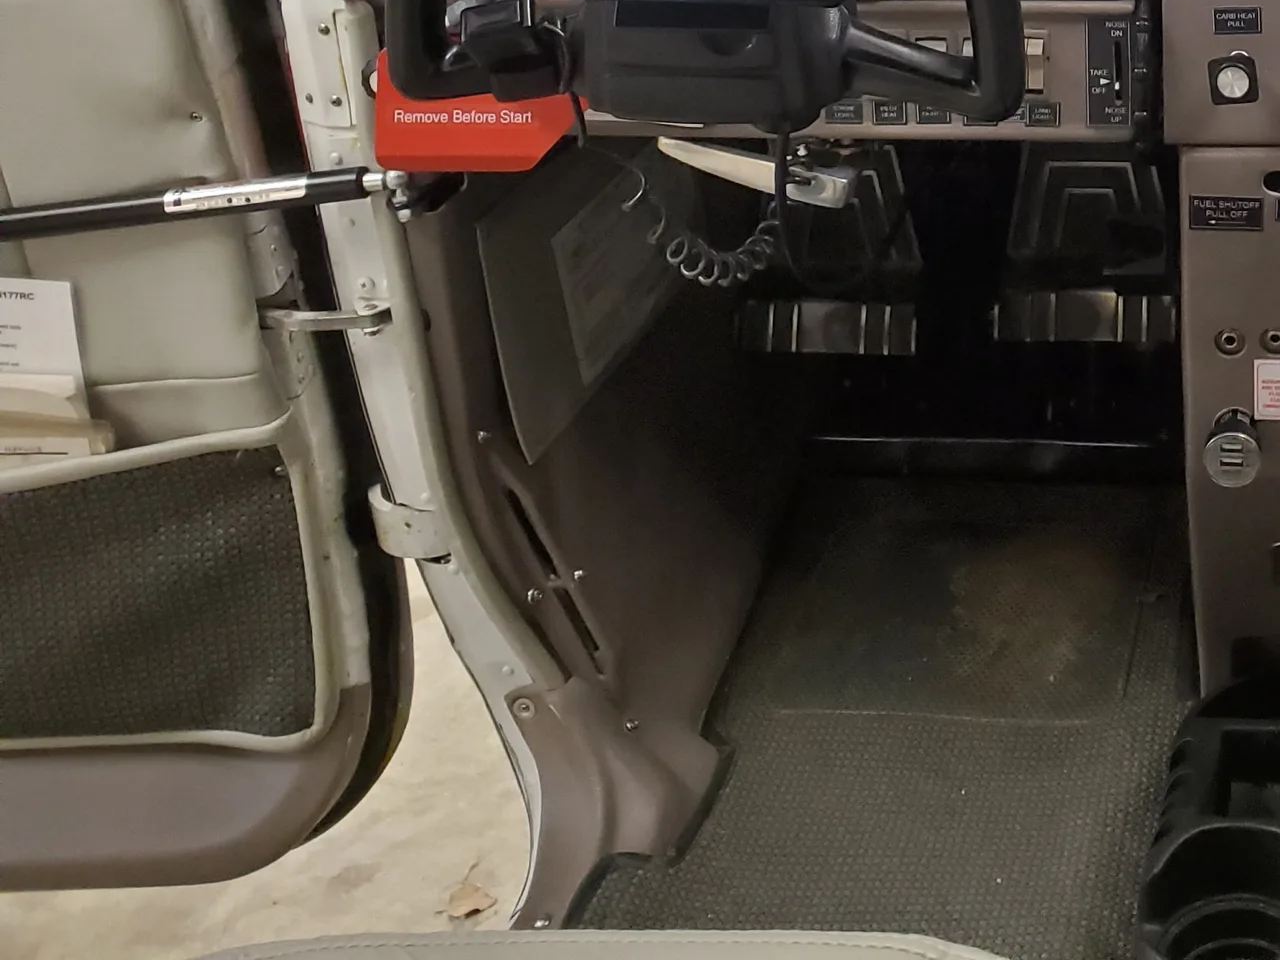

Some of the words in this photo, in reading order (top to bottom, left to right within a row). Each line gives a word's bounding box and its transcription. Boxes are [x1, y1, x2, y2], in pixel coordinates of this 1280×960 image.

[1216, 12, 1236, 20] CARB
[1237, 12, 1256, 20] HEAT
[1227, 20, 1246, 28] PULL
[394, 109, 448, 124] Remove
[453, 109, 496, 124] Before
[500, 109, 532, 124] Start
[1193, 199, 1217, 208] FUEL
[1218, 200, 1261, 209] SHUTOFF
[1205, 209, 1228, 218] PULL
[1229, 210, 1249, 218] OFF
[0, 291, 35, 301] 177RC
